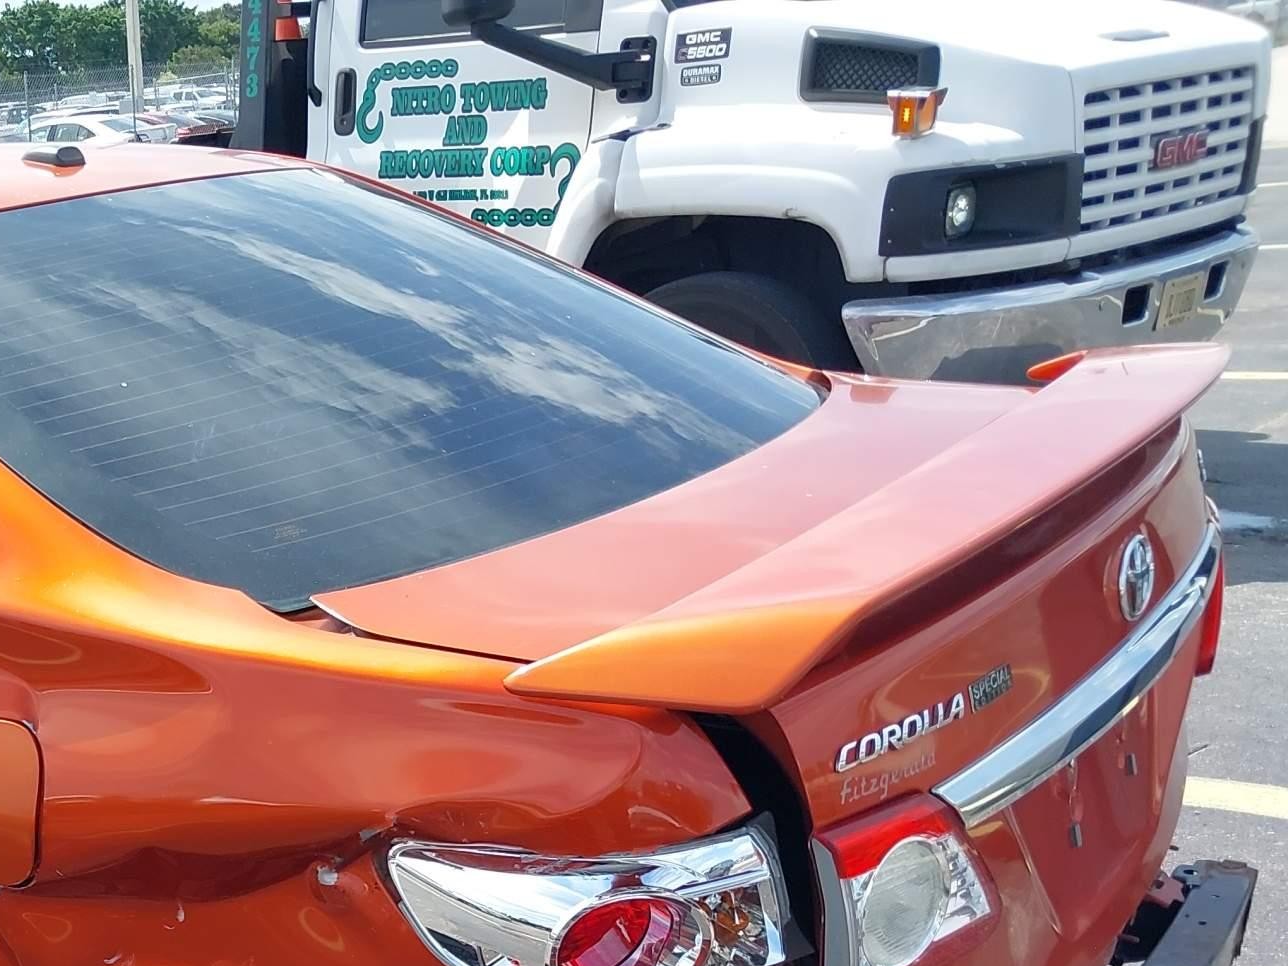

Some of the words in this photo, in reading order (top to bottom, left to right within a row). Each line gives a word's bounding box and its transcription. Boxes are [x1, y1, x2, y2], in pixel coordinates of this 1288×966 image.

[685, 31, 722, 45] GMC
[682, 66, 720, 77] DURAMAX
[391, 84, 456, 116] NITRO
[460, 77, 548, 113] TOWING
[442, 115, 488, 146] AND
[378, 148, 488, 179] RECOVERY
[490, 145, 552, 176] CORP
[1157, 130, 1210, 168] GMC
[835, 692, 964, 773] COROLLA
[973, 665, 1011, 699] SPECIAL
